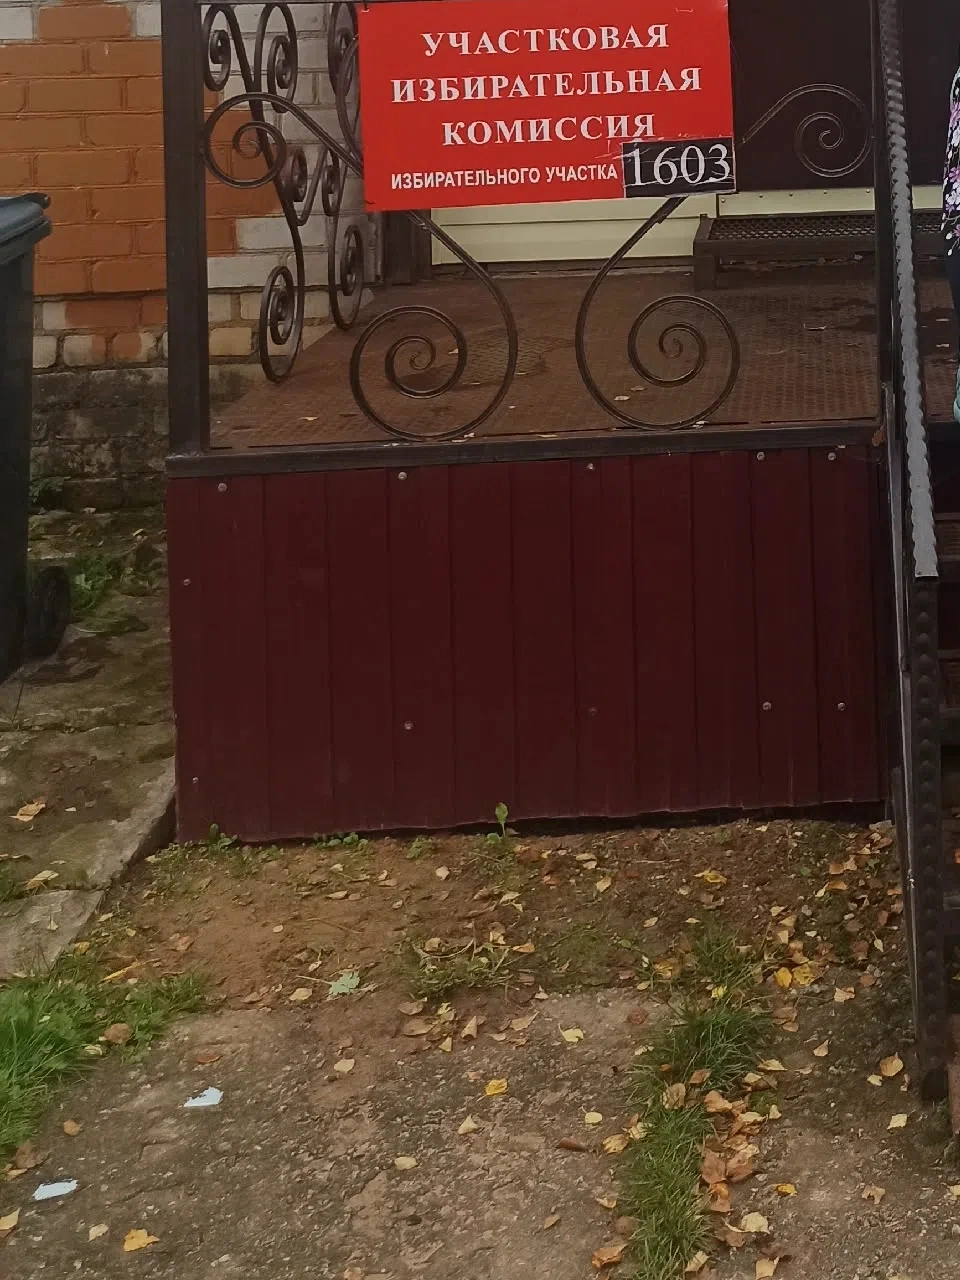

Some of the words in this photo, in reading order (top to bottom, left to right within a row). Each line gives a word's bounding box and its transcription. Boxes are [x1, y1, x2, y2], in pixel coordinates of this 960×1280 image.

[421, 24, 668, 57] УЧАСТКОВАЯ
[391, 67, 702, 103] ИЗБИРАТЕЛЬНАЯ
[442, 113, 656, 146] КОМИССИЯ
[391, 167, 541, 189] ИЗБИРАТЕЛЬНОГО
[546, 163, 618, 184] УЧАСТКА
[632, 143, 731, 186] 1603
